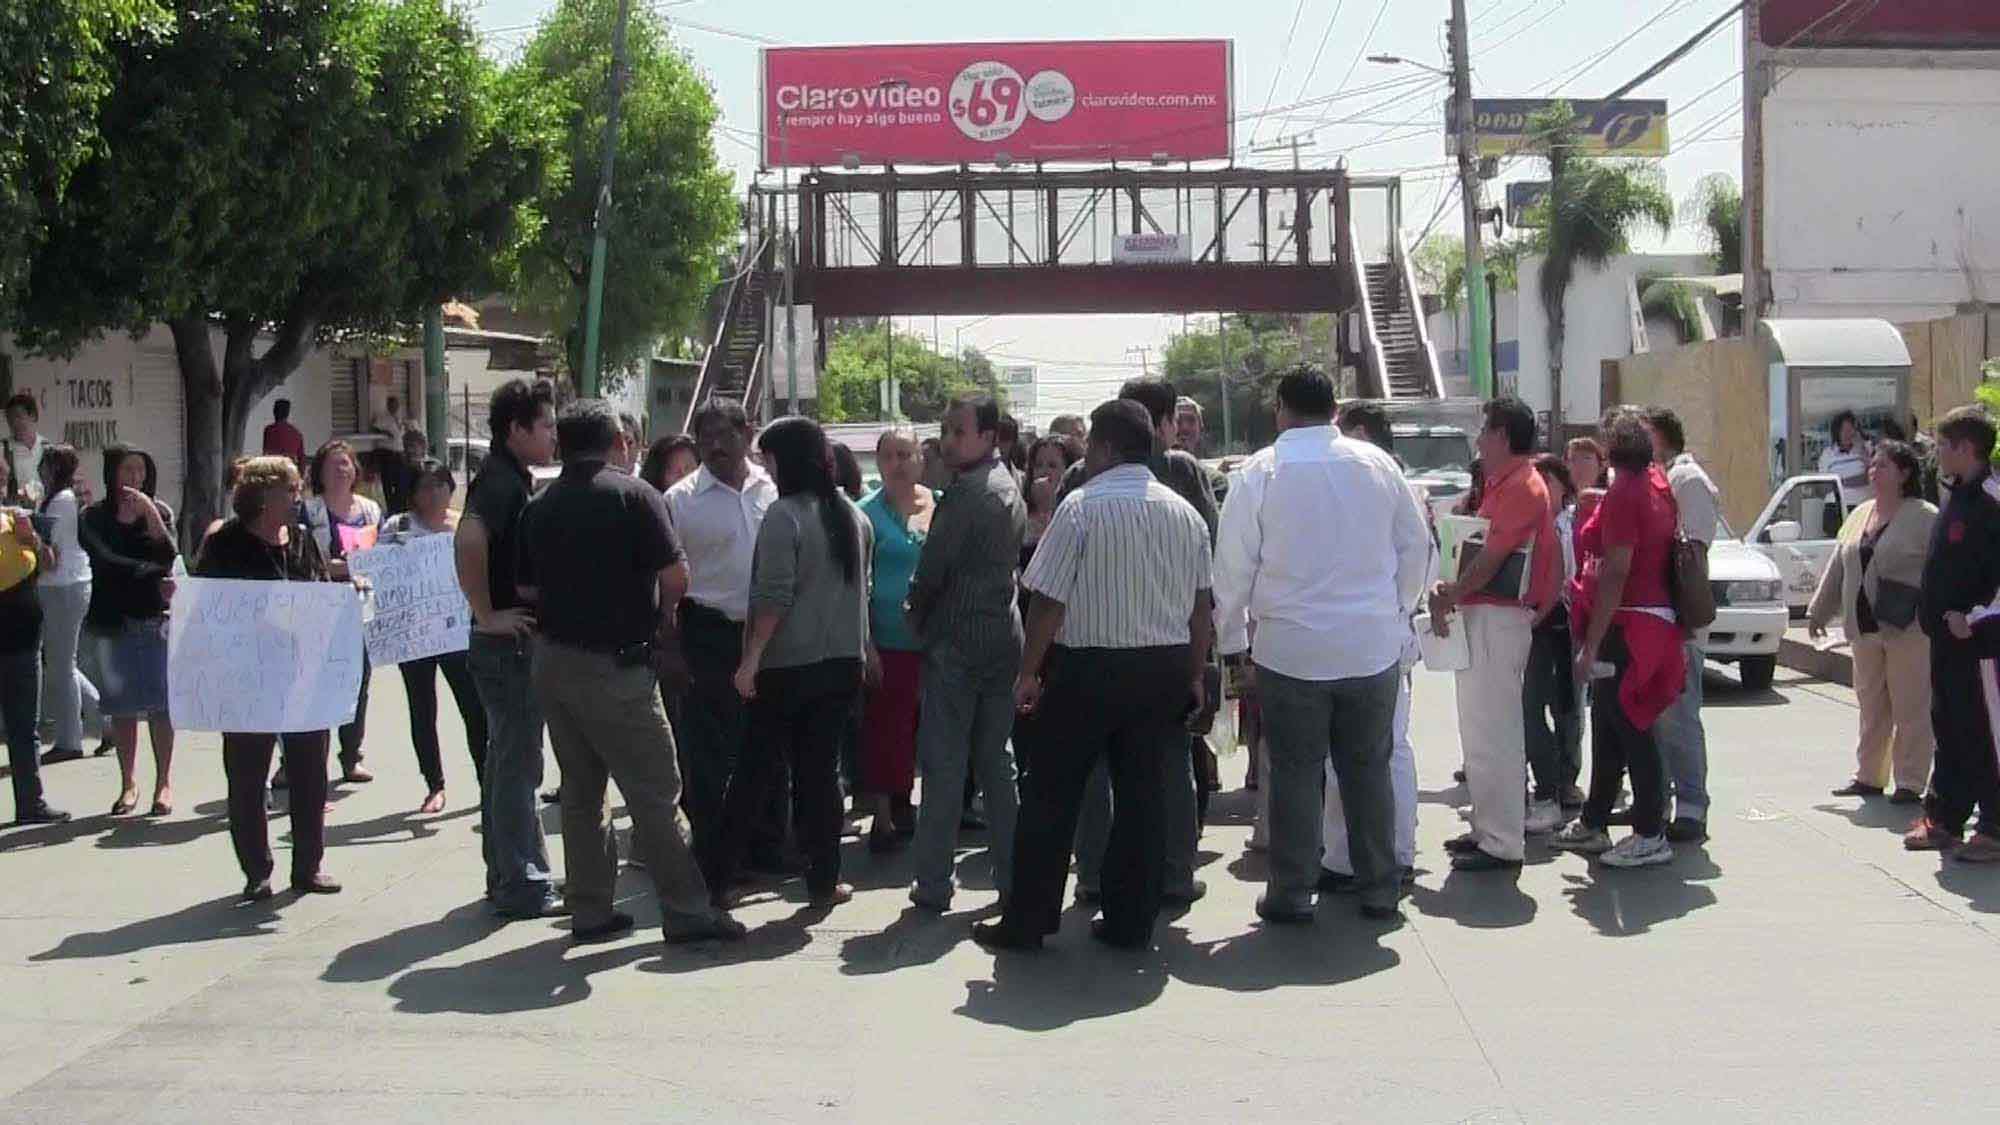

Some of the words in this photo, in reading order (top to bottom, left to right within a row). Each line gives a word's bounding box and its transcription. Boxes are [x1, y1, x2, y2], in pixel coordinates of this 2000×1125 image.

[1080, 91, 1217, 108] clarovideo.com.mx
[838, 112, 864, 126] hay
[865, 112, 896, 126] algo
[898, 111, 942, 124] bueno
[67, 379, 113, 409] TACOS
